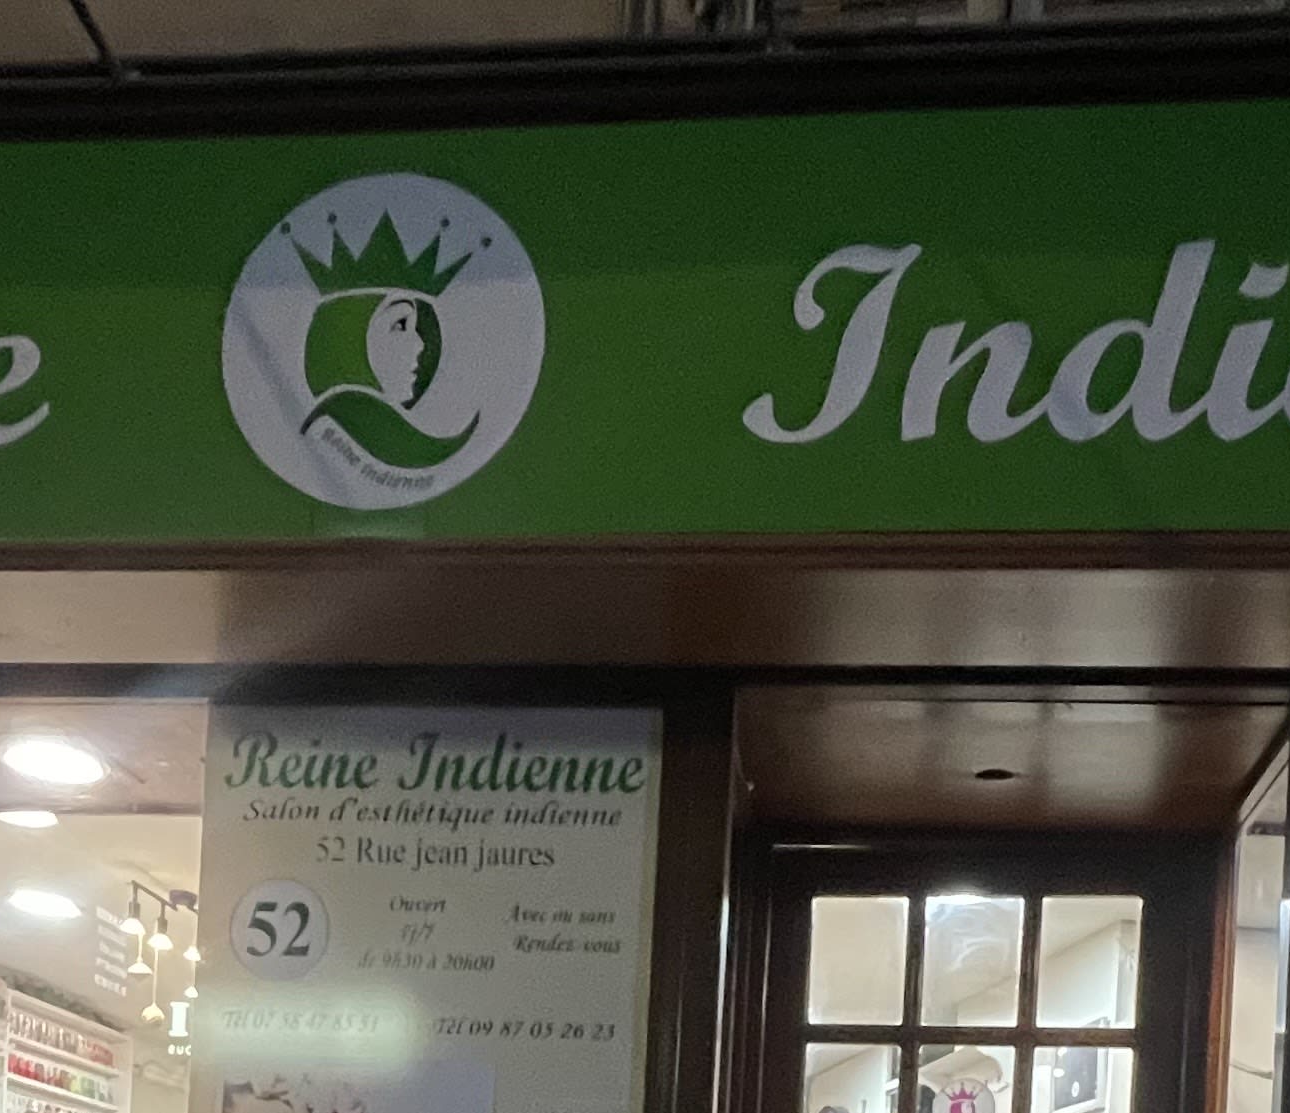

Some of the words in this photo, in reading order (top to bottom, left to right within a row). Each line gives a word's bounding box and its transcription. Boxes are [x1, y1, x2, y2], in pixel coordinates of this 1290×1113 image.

[224, 731, 380, 790] Reine
[398, 731, 645, 793] Indienne
[243, 798, 320, 822] Salon
[329, 797, 495, 833] d'esthétique
[504, 800, 623, 827] indienne
[315, 837, 347, 862] 52
[356, 838, 408, 866] Rue
[411, 837, 469, 871] jean
[474, 838, 557, 872] jaures
[389, 895, 447, 913] Ouvert
[506, 903, 547, 923] Avec
[553, 909, 573, 923] ou
[579, 910, 617, 925] sans
[247, 901, 311, 957] 52
[513, 932, 575, 954] Rendez
[583, 938, 622, 955] vous
[469, 1018, 495, 1037] 09
[500, 1020, 525, 1039] 87
[529, 1020, 555, 1040] 05
[560, 1021, 586, 1041] 26
[592, 1022, 617, 1042] 23
